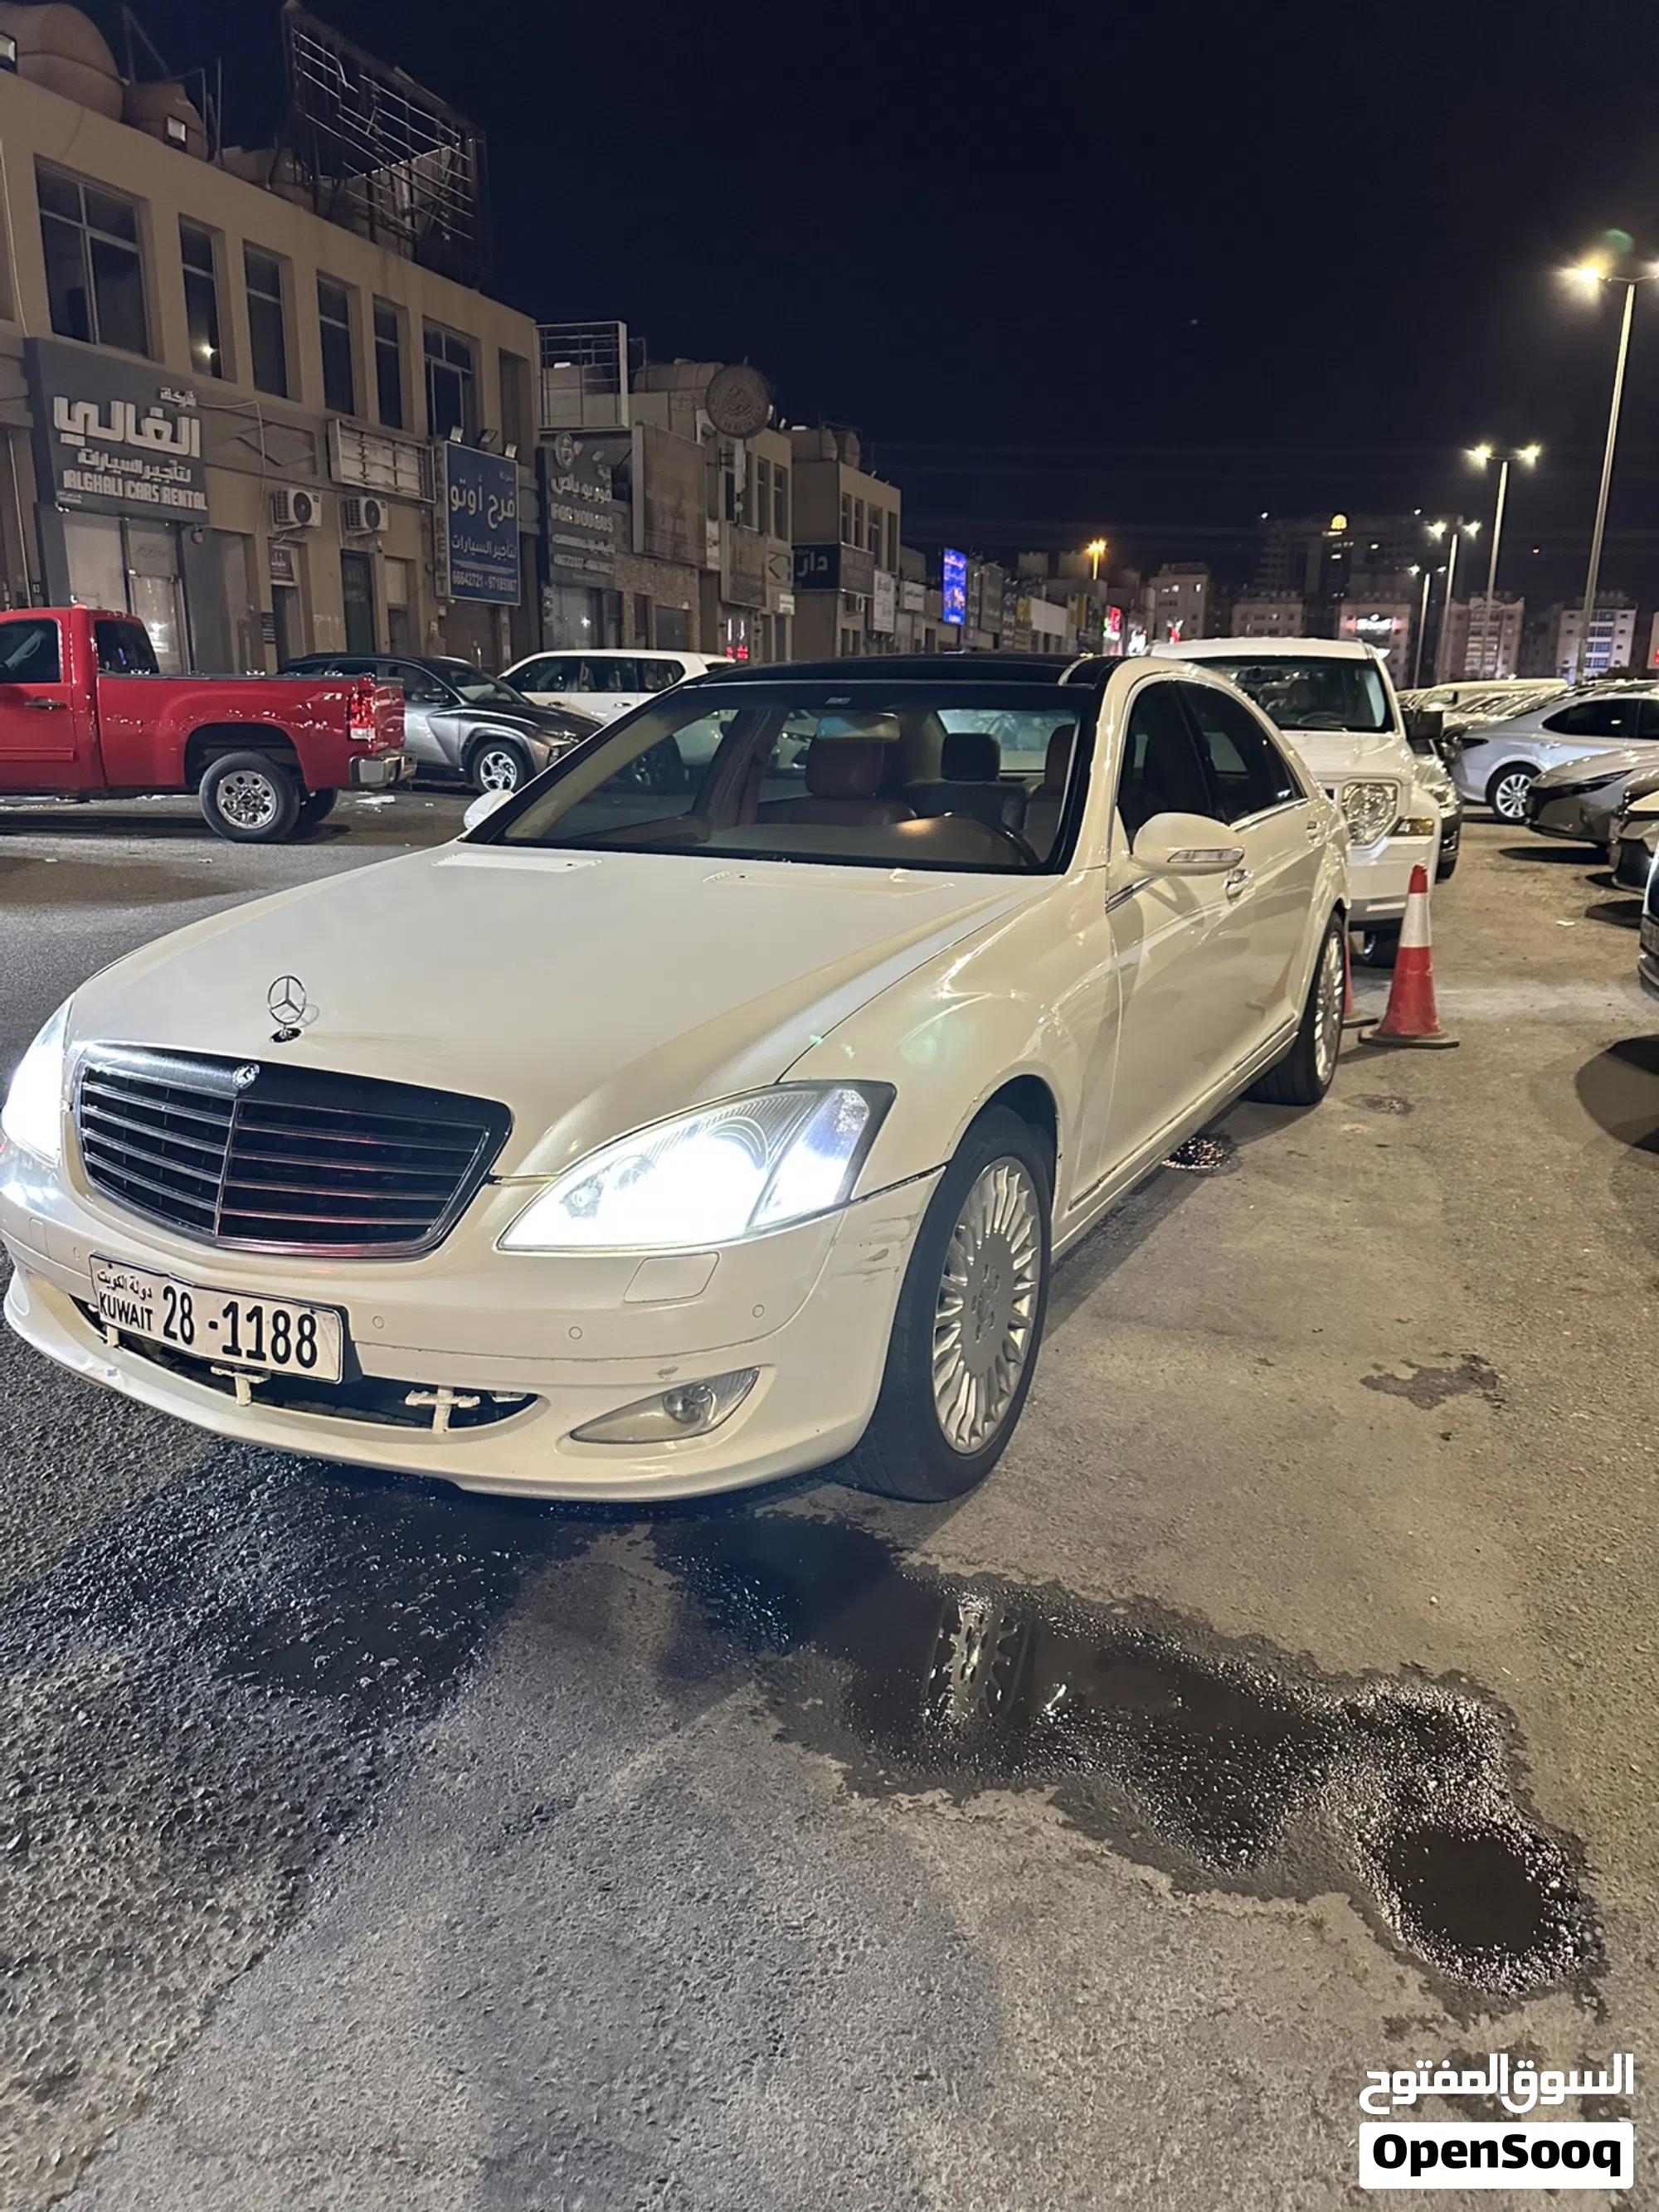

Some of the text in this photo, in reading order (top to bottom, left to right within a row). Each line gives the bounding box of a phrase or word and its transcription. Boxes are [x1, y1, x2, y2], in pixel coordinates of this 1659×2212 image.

[53, 396, 200, 457] الغالي
[78, 449, 143, 474] السيارات
[63, 470, 123, 497] ALGHALI
[126, 480, 159, 503] CARS
[159, 487, 207, 510] RENTAL
[450, 475, 515, 529] فرح أوتو
[451, 534, 493, 555] السيارات
[97, 1267, 153, 1300] دولة الكويت
[99, 1292, 153, 1331] KUWAIT
[163, 1286, 195, 1345] 28
